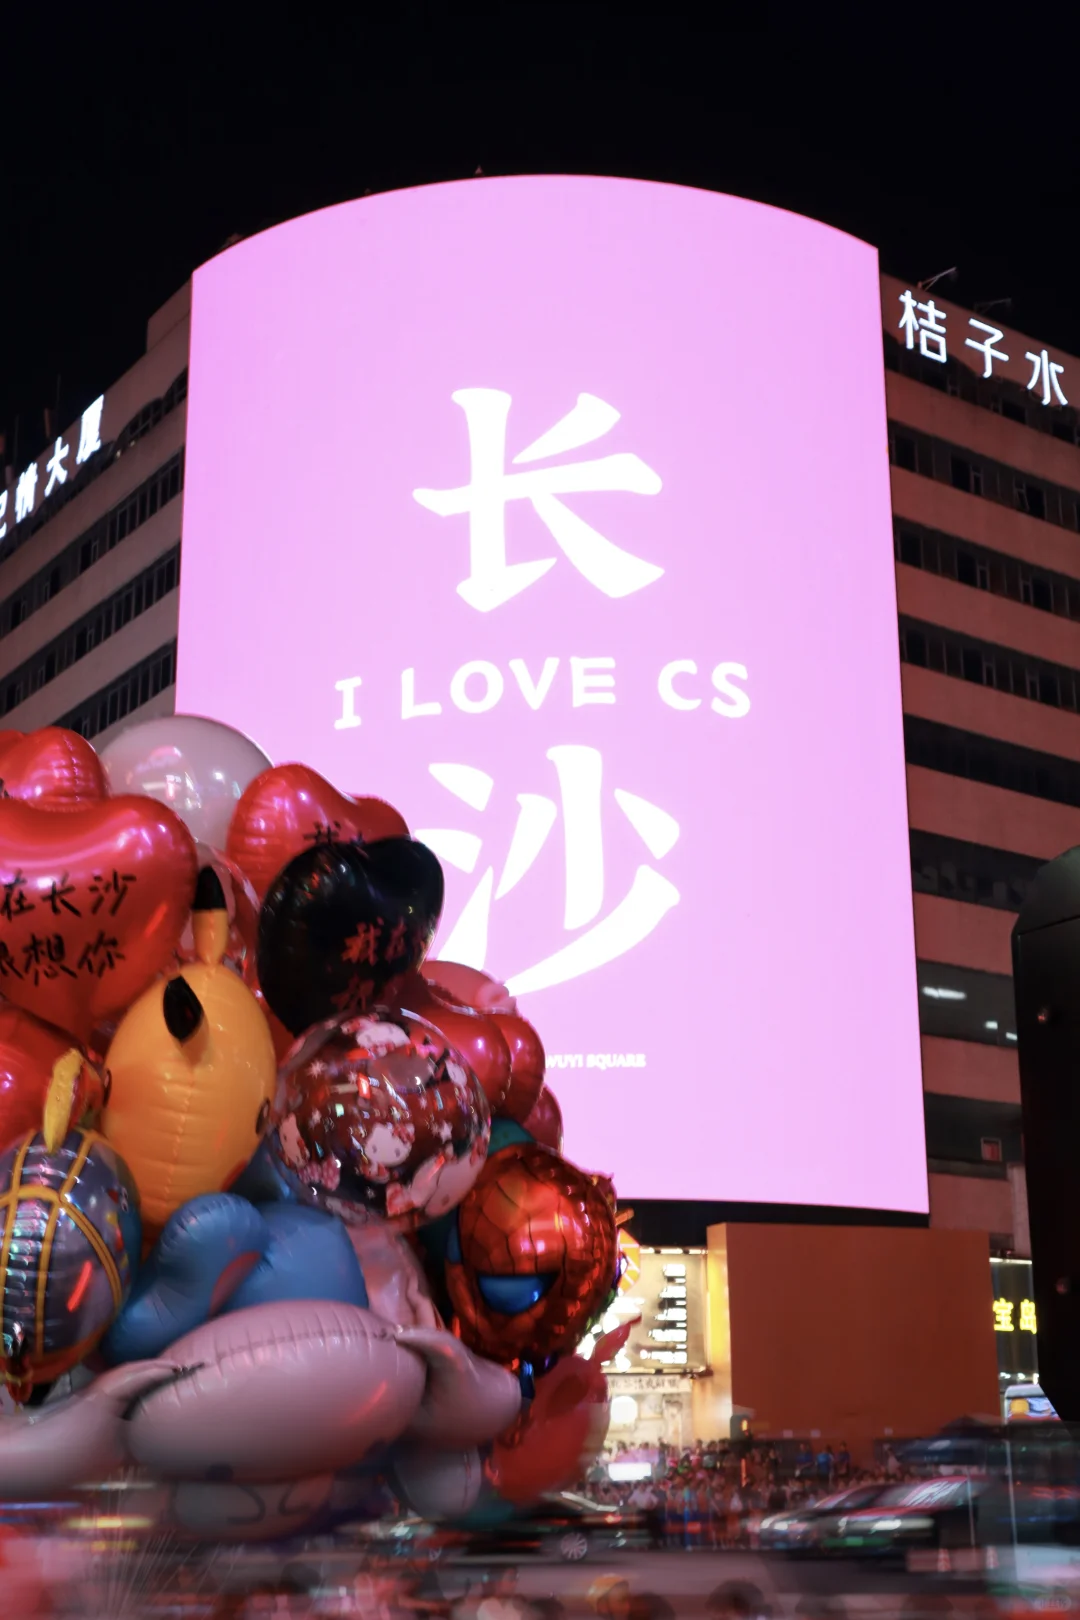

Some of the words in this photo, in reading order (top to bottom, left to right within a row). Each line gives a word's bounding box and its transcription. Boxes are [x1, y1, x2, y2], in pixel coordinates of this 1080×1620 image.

[899, 289, 1068, 406] 桔子水
[412, 387, 665, 613] 长
[333, 676, 363, 730] I
[400, 656, 617, 720] LOVE
[657, 659, 752, 718] CS
[413, 744, 681, 997] 沙
[586, 1053, 647, 1070] SQUARE
[992, 1297, 1038, 1335] 宝岛
